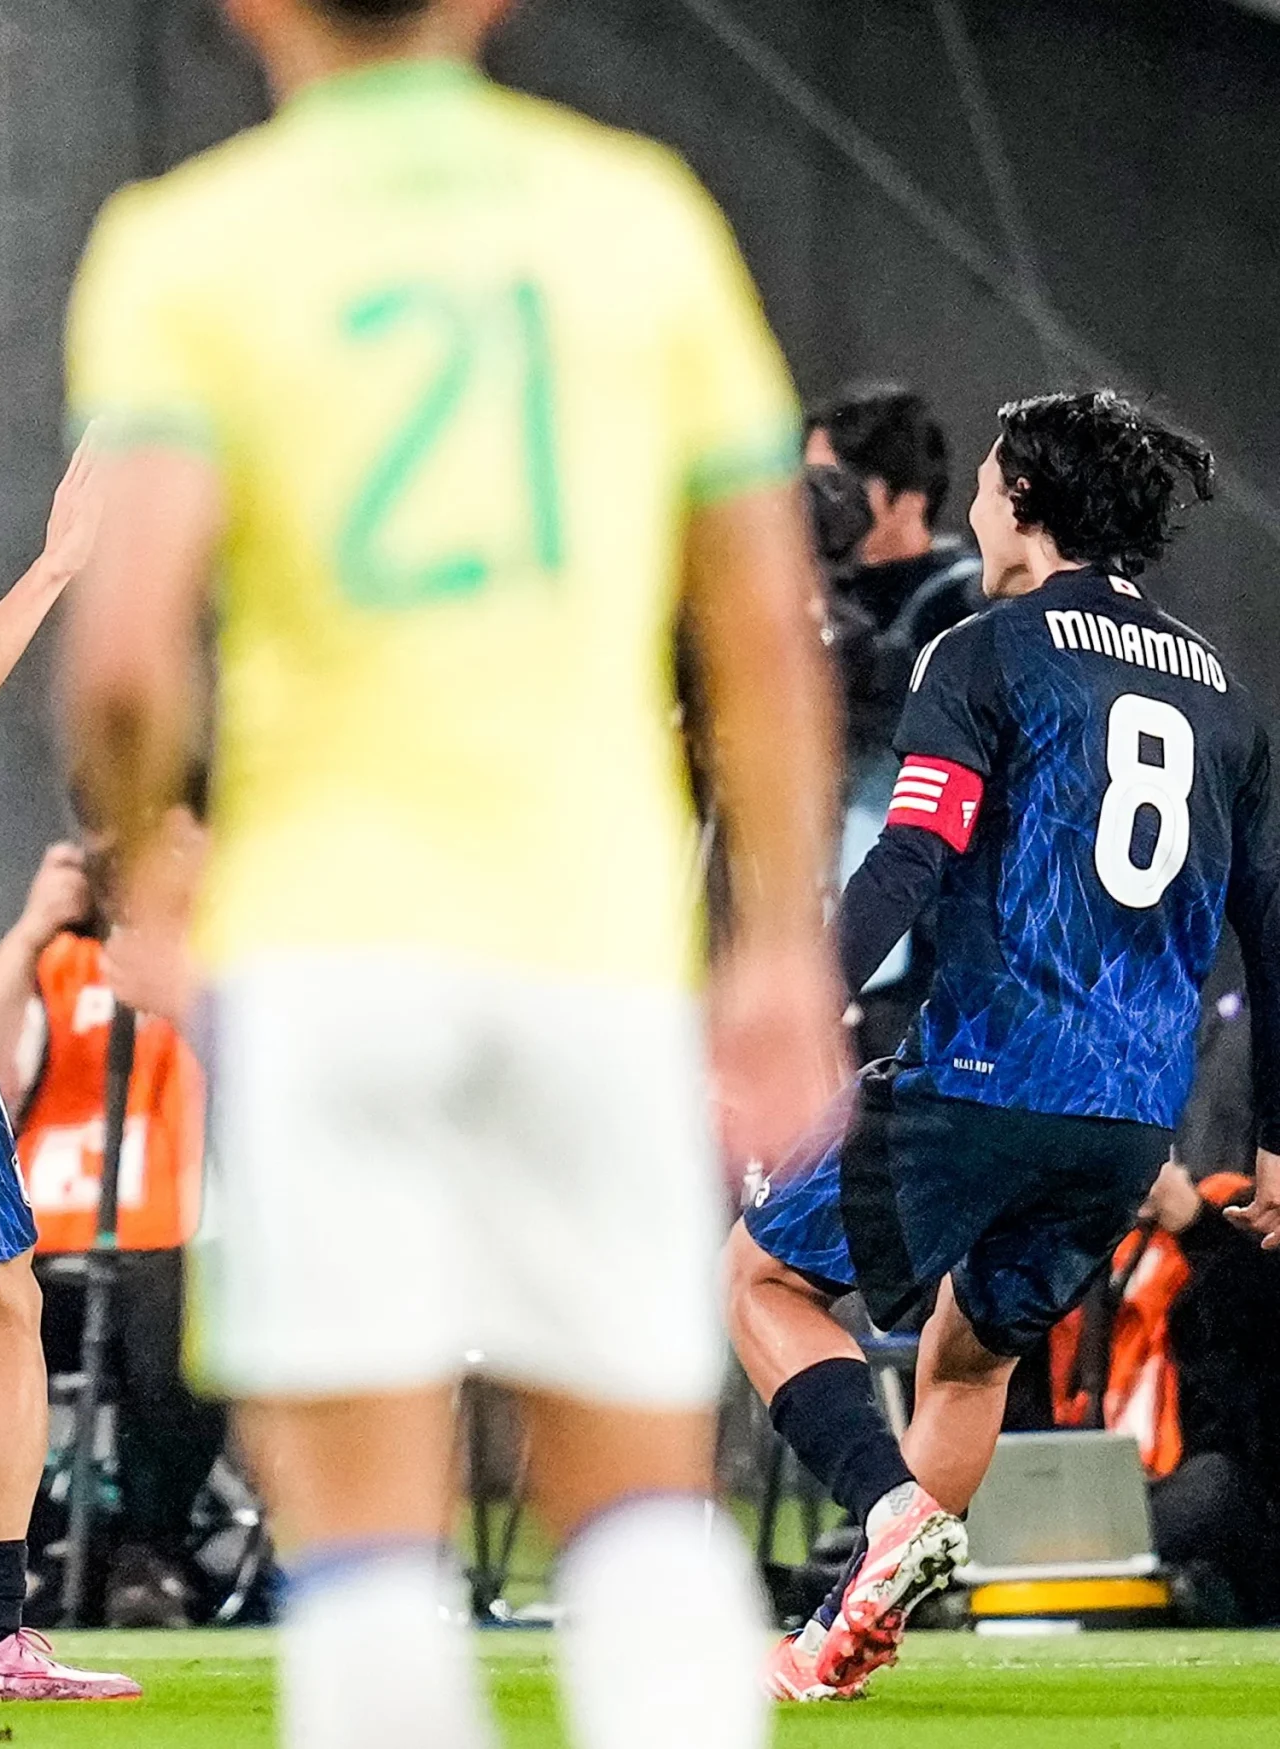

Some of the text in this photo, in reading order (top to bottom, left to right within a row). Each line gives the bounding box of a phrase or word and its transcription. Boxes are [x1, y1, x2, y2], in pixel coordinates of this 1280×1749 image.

[338, 276, 562, 606] 21
[1044, 610, 1227, 693] MINAMINO
[1094, 692, 1195, 909] 8
